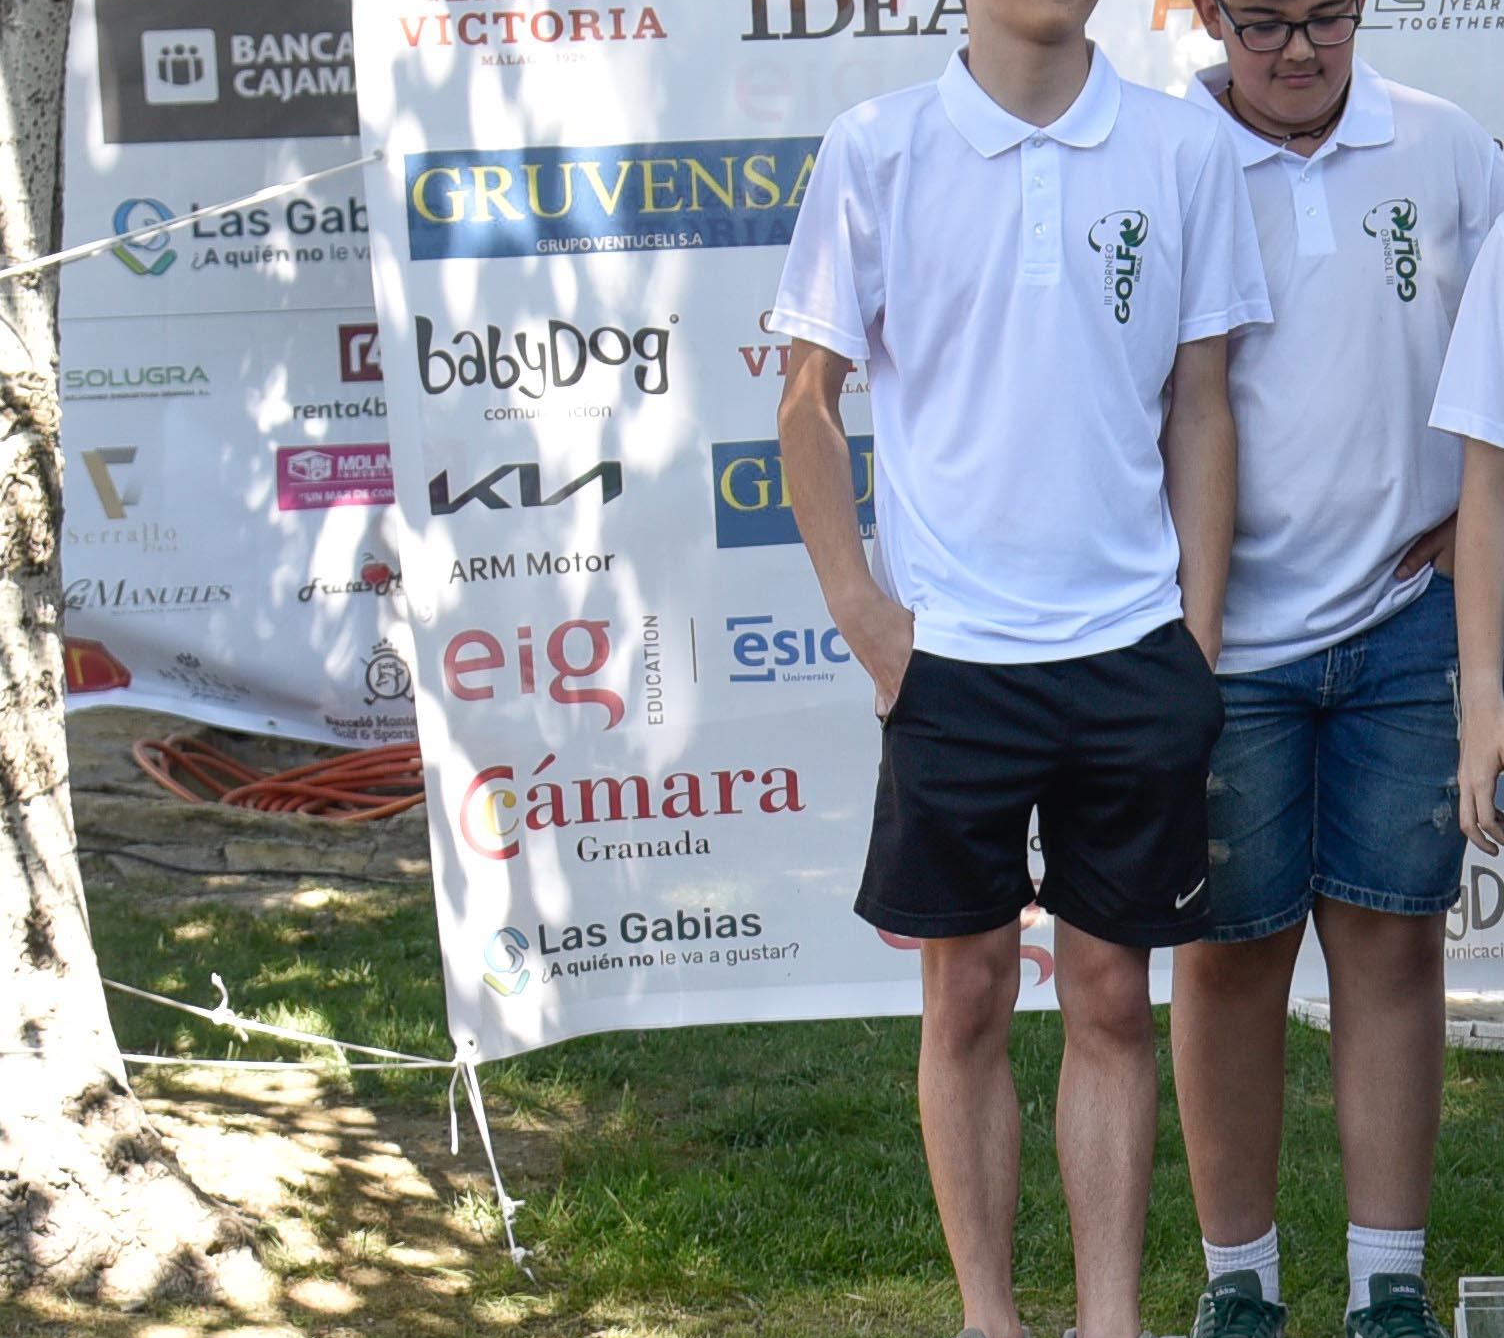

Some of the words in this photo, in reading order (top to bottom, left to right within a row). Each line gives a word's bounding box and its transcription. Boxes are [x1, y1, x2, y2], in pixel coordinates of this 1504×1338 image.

[399, 7, 668, 47] VICTORIA
[231, 31, 354, 65] BANCA
[233, 65, 358, 102] CAJAM
[191, 202, 271, 238] Las
[285, 196, 370, 235] Gab
[296, 247, 324, 261] no
[329, 243, 349, 260] le
[536, 238, 592, 254] GRUPO
[594, 235, 676, 252] VENTUCELI
[1380, 228, 1394, 272] TORNEO
[1104, 243, 1114, 294] TORNEO
[1391, 228, 1417, 303] GOLF
[1104, 295, 1113, 306] III
[1114, 244, 1137, 325] GOLF
[65, 365, 210, 389] SOLUGRA
[292, 396, 387, 420] renta4b
[449, 556, 518, 585] ARM
[526, 550, 616, 578] Motor
[443, 617, 625, 731] eig
[644, 614, 665, 727] EDUCATION
[782, 671, 835, 683] University
[576, 829, 711, 864] Granada
[537, 921, 608, 955] Las
[618, 907, 763, 945] Gabias
[567, 953, 628, 979] quién
[631, 952, 655, 968] no
[659, 948, 678, 966] le
[681, 949, 705, 965] va
[709, 949, 721, 963] a
[725, 941, 801, 967] gustar?
